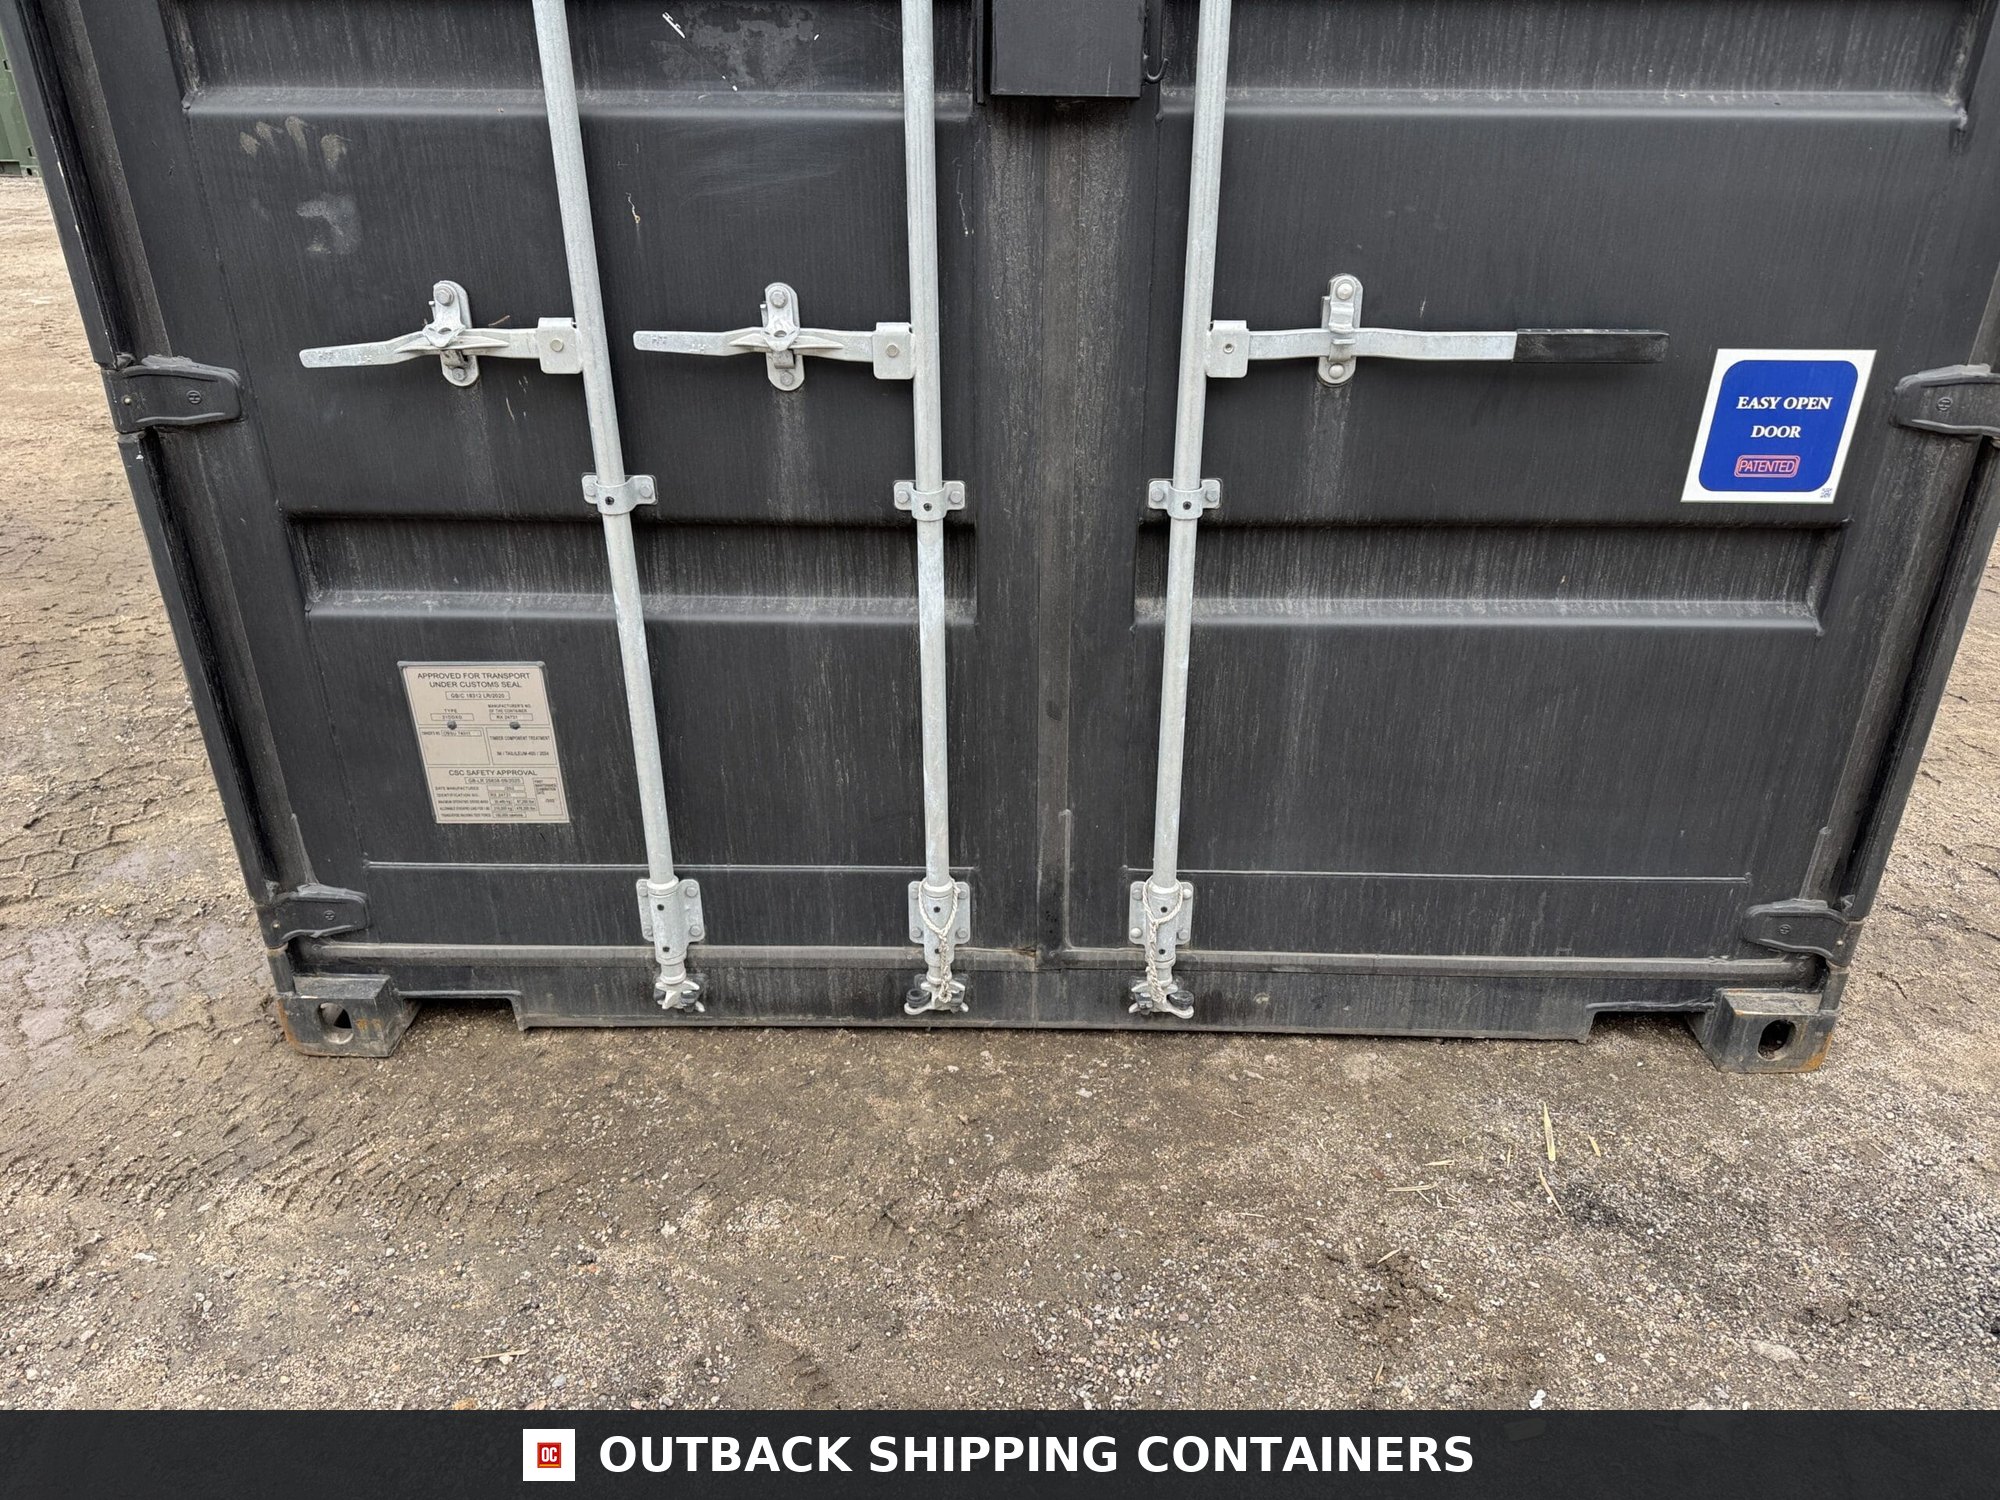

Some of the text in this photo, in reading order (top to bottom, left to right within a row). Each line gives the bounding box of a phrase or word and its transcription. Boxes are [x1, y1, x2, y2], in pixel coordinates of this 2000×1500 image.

[1736, 396, 1832, 410] EASY OPEN
[1751, 426, 1802, 438] DOOR
[1739, 460, 1794, 472] PATENTED
